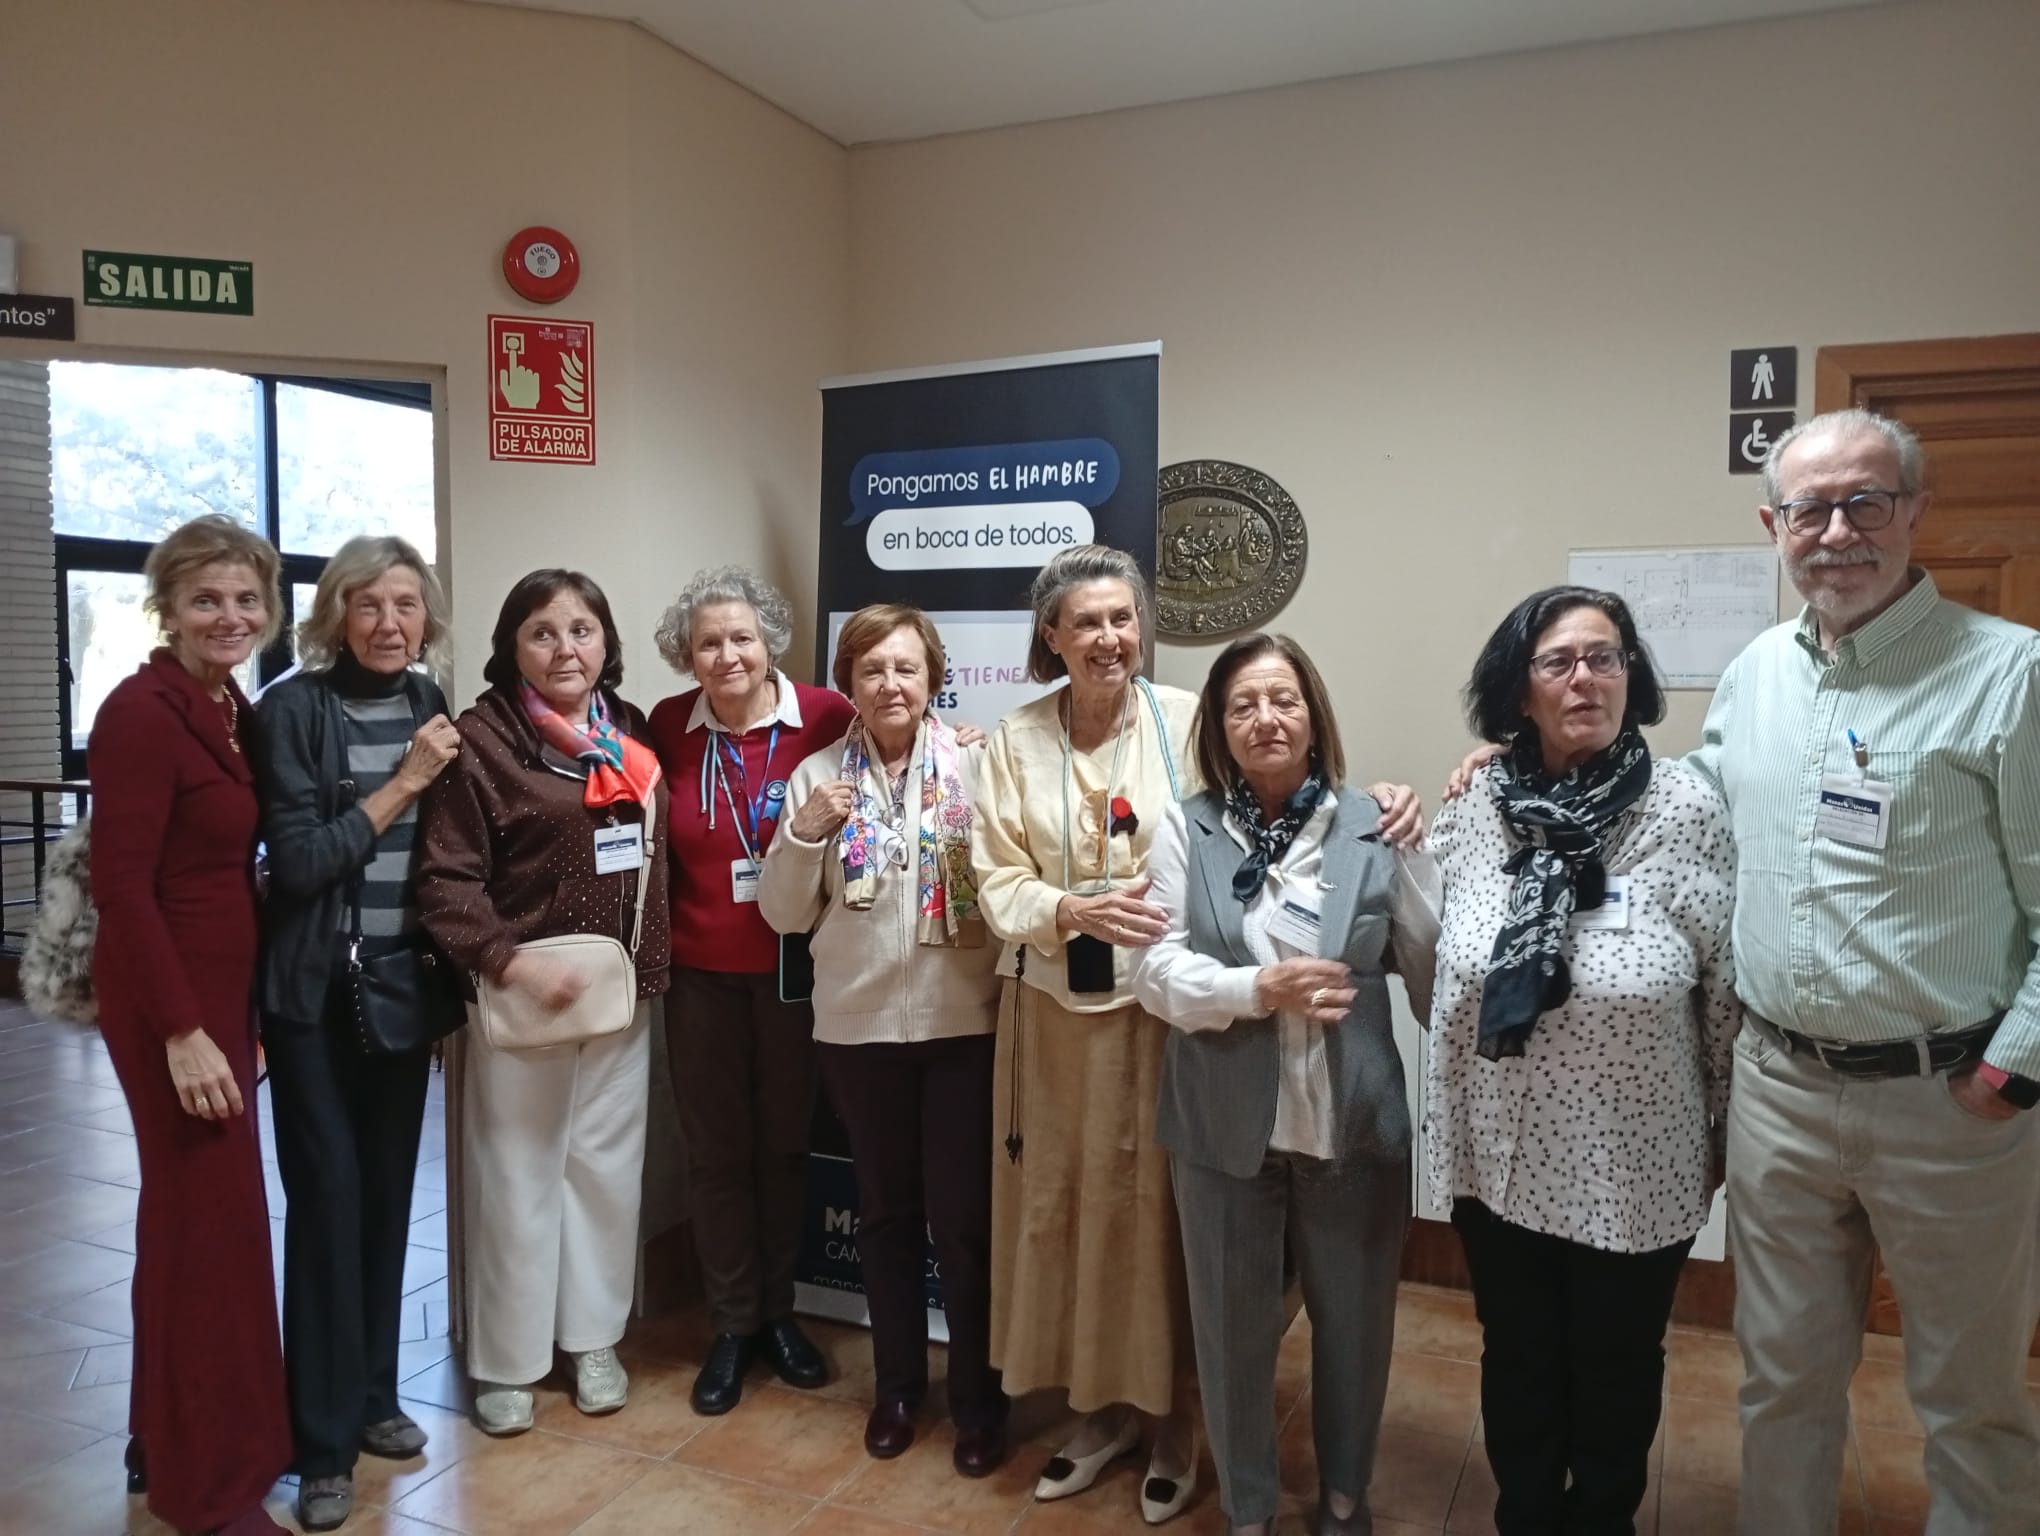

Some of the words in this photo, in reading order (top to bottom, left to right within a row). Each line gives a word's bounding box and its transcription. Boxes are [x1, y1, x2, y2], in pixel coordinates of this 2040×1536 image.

[99, 263, 238, 304] SALIDA
[500, 424, 585, 441] PULSADOR
[500, 439, 520, 452] DE
[523, 440, 587, 456] ALARMA
[867, 471, 979, 501] Pongamos
[989, 467, 1009, 490] EL
[1015, 460, 1098, 491] HAMBRE
[883, 531, 910, 550] en
[916, 526, 968, 549] boca
[975, 523, 1004, 547] de
[1009, 521, 1077, 546] todos.
